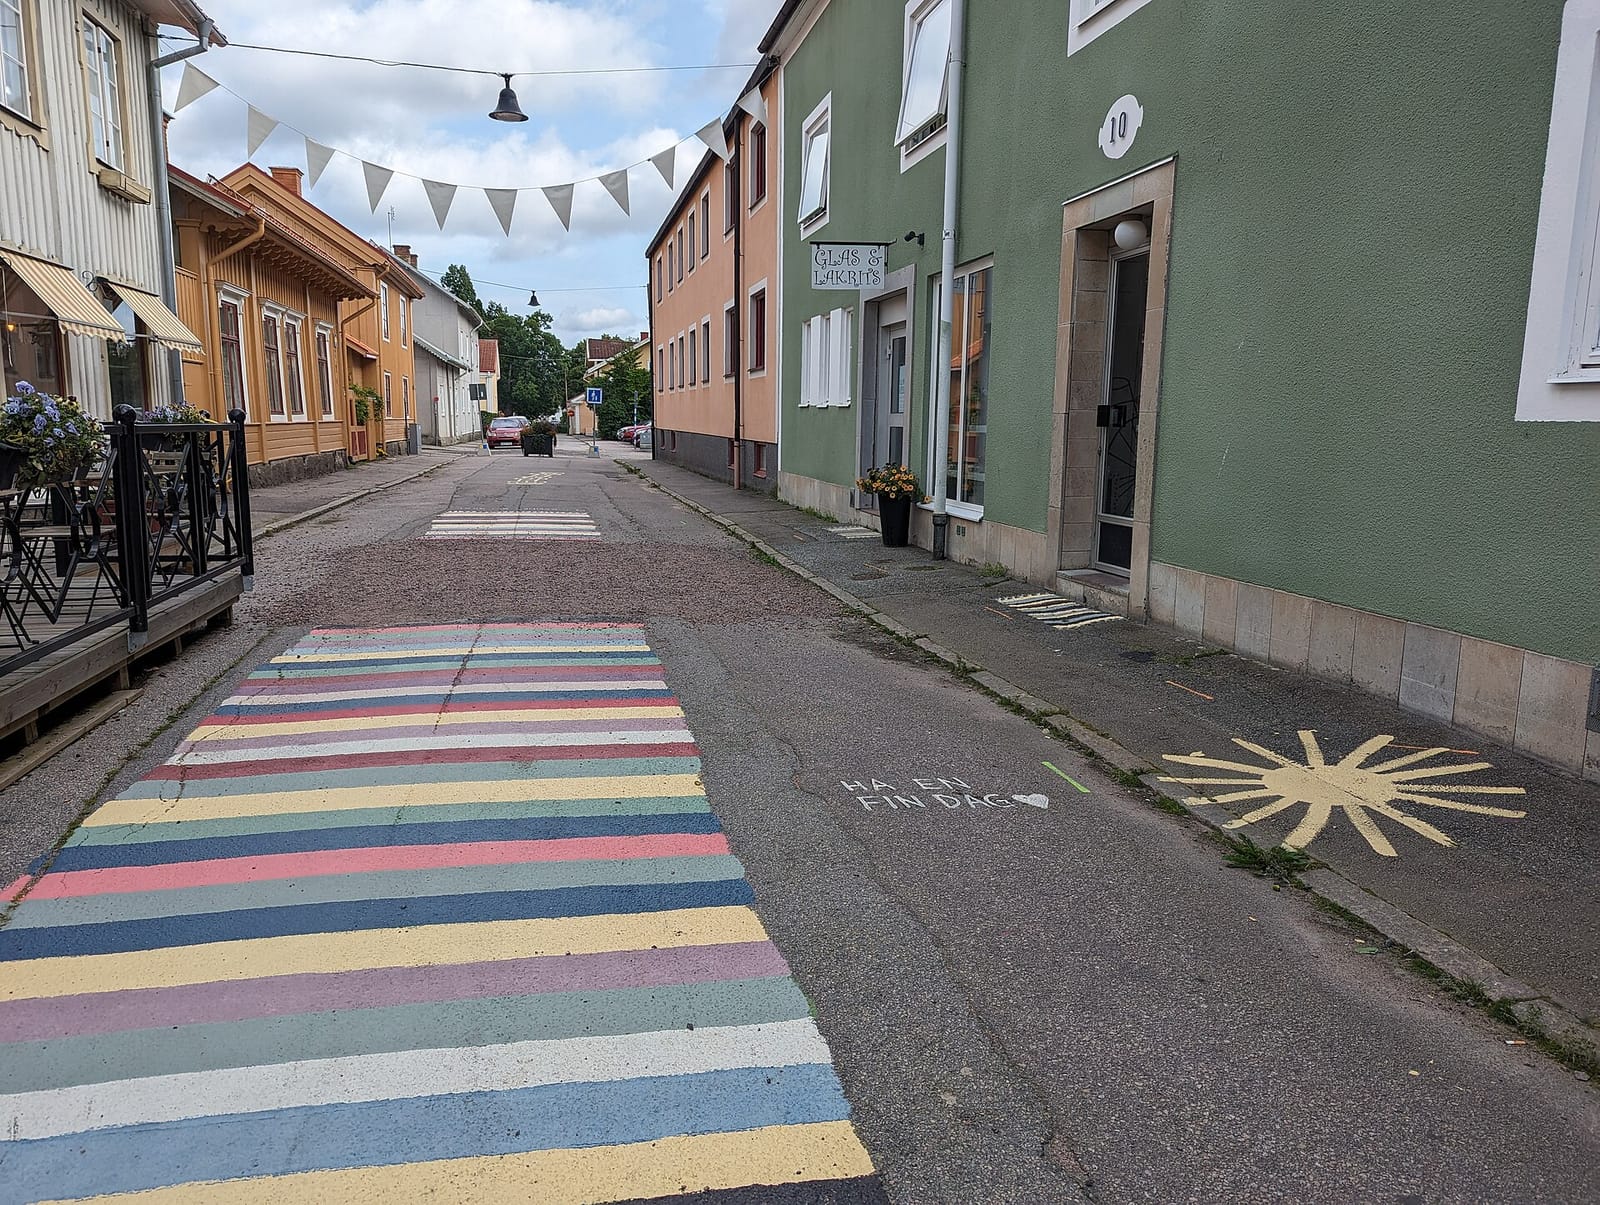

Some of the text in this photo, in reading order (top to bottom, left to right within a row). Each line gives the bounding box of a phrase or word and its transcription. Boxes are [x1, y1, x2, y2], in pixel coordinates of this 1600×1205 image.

[1110, 111, 1127, 144] 10
[814, 248, 883, 270] GLAS &
[814, 268, 881, 287] LAKRITS
[840, 777, 971, 791] HA EN
[856, 794, 1017, 811] FIN DAG
